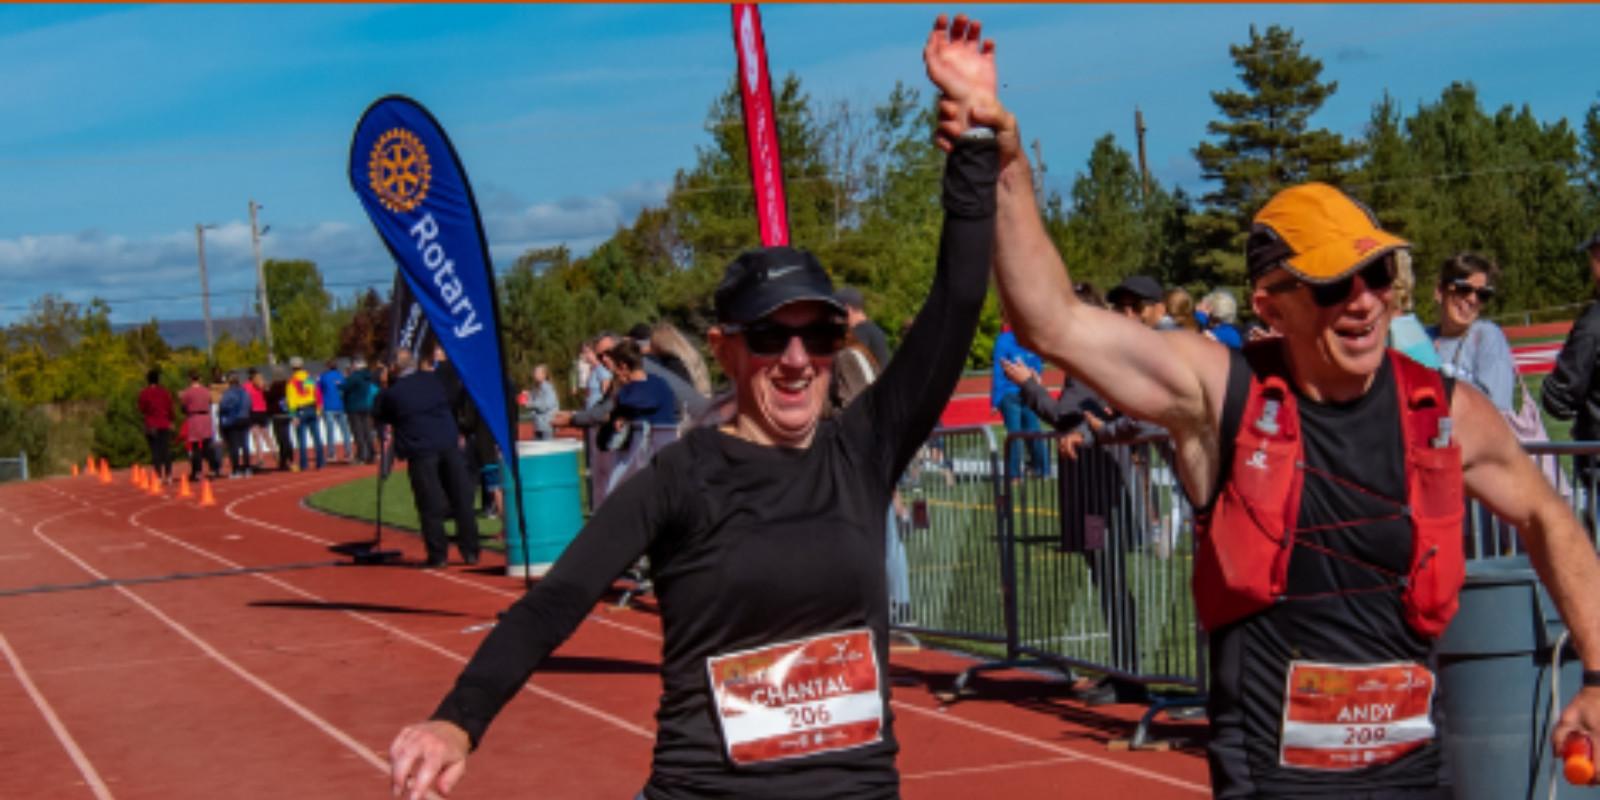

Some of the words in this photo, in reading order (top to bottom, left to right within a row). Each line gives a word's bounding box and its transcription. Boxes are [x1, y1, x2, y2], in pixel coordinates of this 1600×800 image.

[410, 213, 483, 338] Rotary
[752, 675, 852, 705] CHANTAL
[785, 704, 831, 728] 206
[1337, 703, 1396, 722] ANDY
